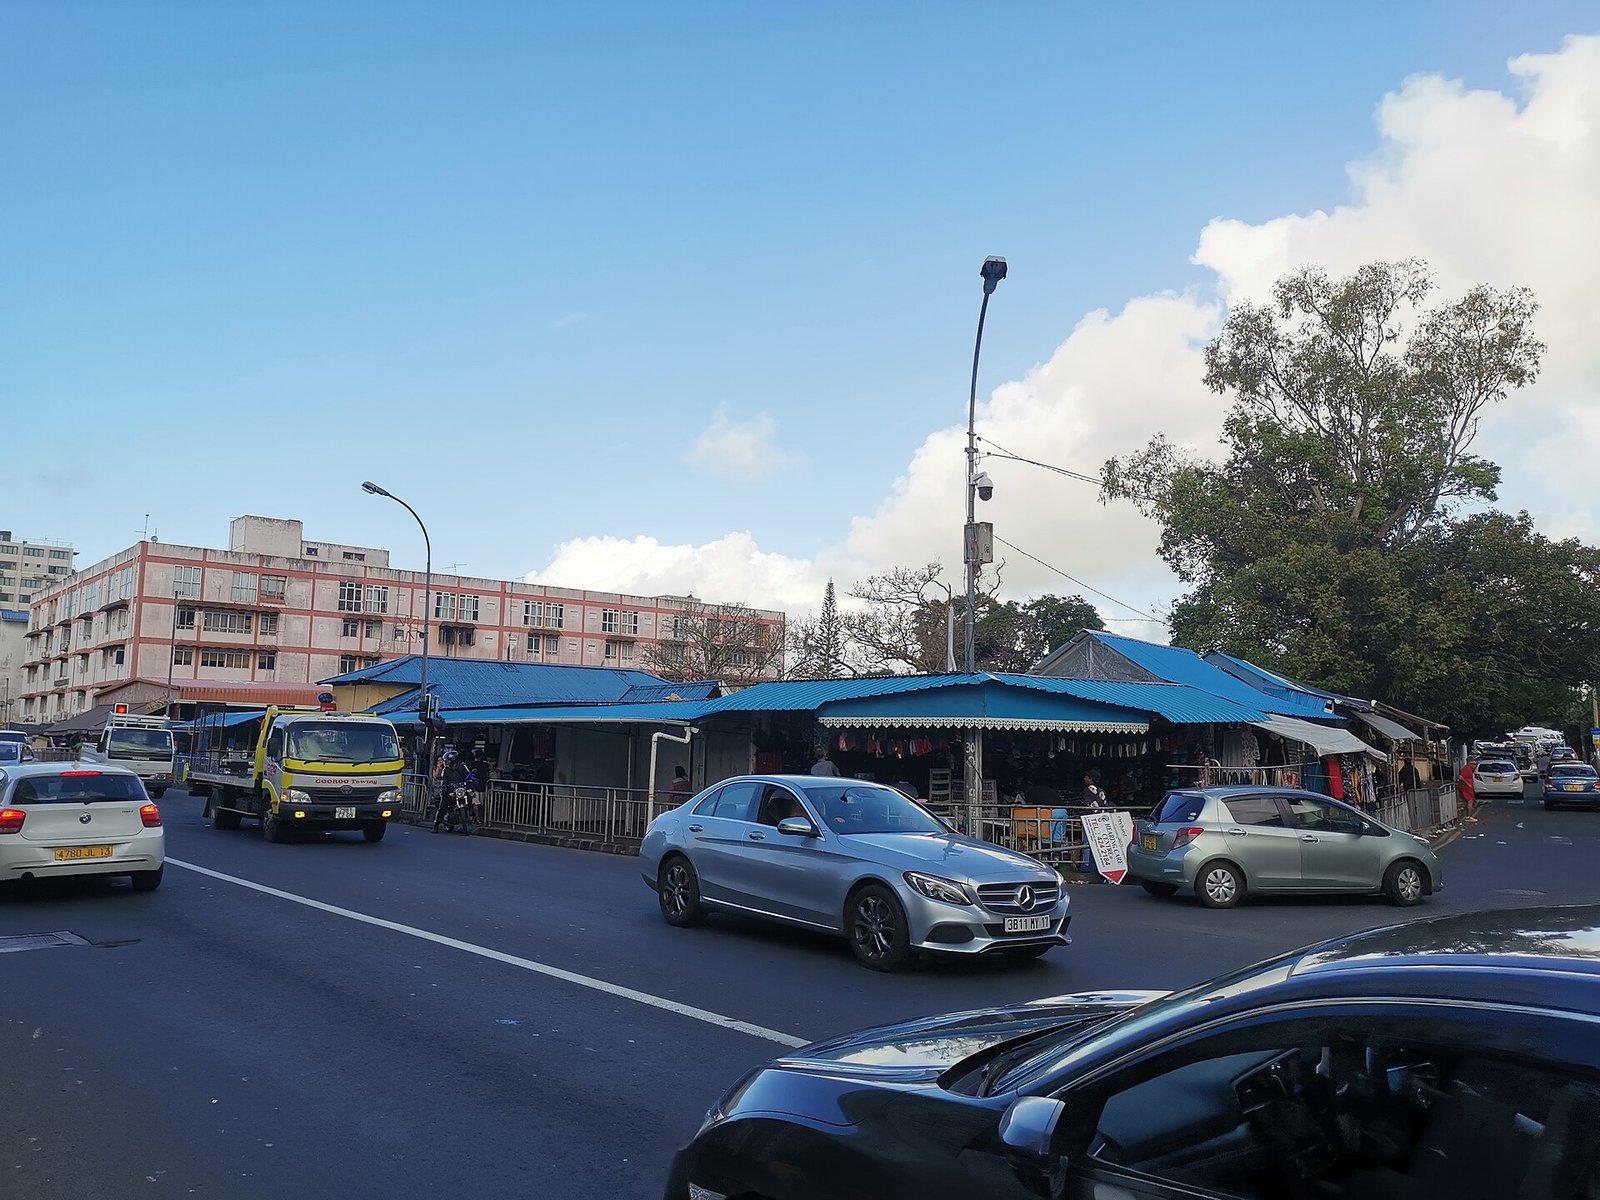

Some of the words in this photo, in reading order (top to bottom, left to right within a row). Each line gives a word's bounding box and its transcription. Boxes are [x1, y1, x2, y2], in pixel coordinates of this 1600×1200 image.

[1097, 836, 1105, 848] 424
[1105, 823, 1117, 849] HEARING
[1114, 849, 1124, 865] CARE
[56, 849, 82, 859] 4780
[85, 848, 95, 857] JL
[100, 847, 111, 856] 13
[1100, 850, 1111, 867] 2184
[1007, 919, 1028, 931] 3811
[1041, 916, 1049, 928] 17
